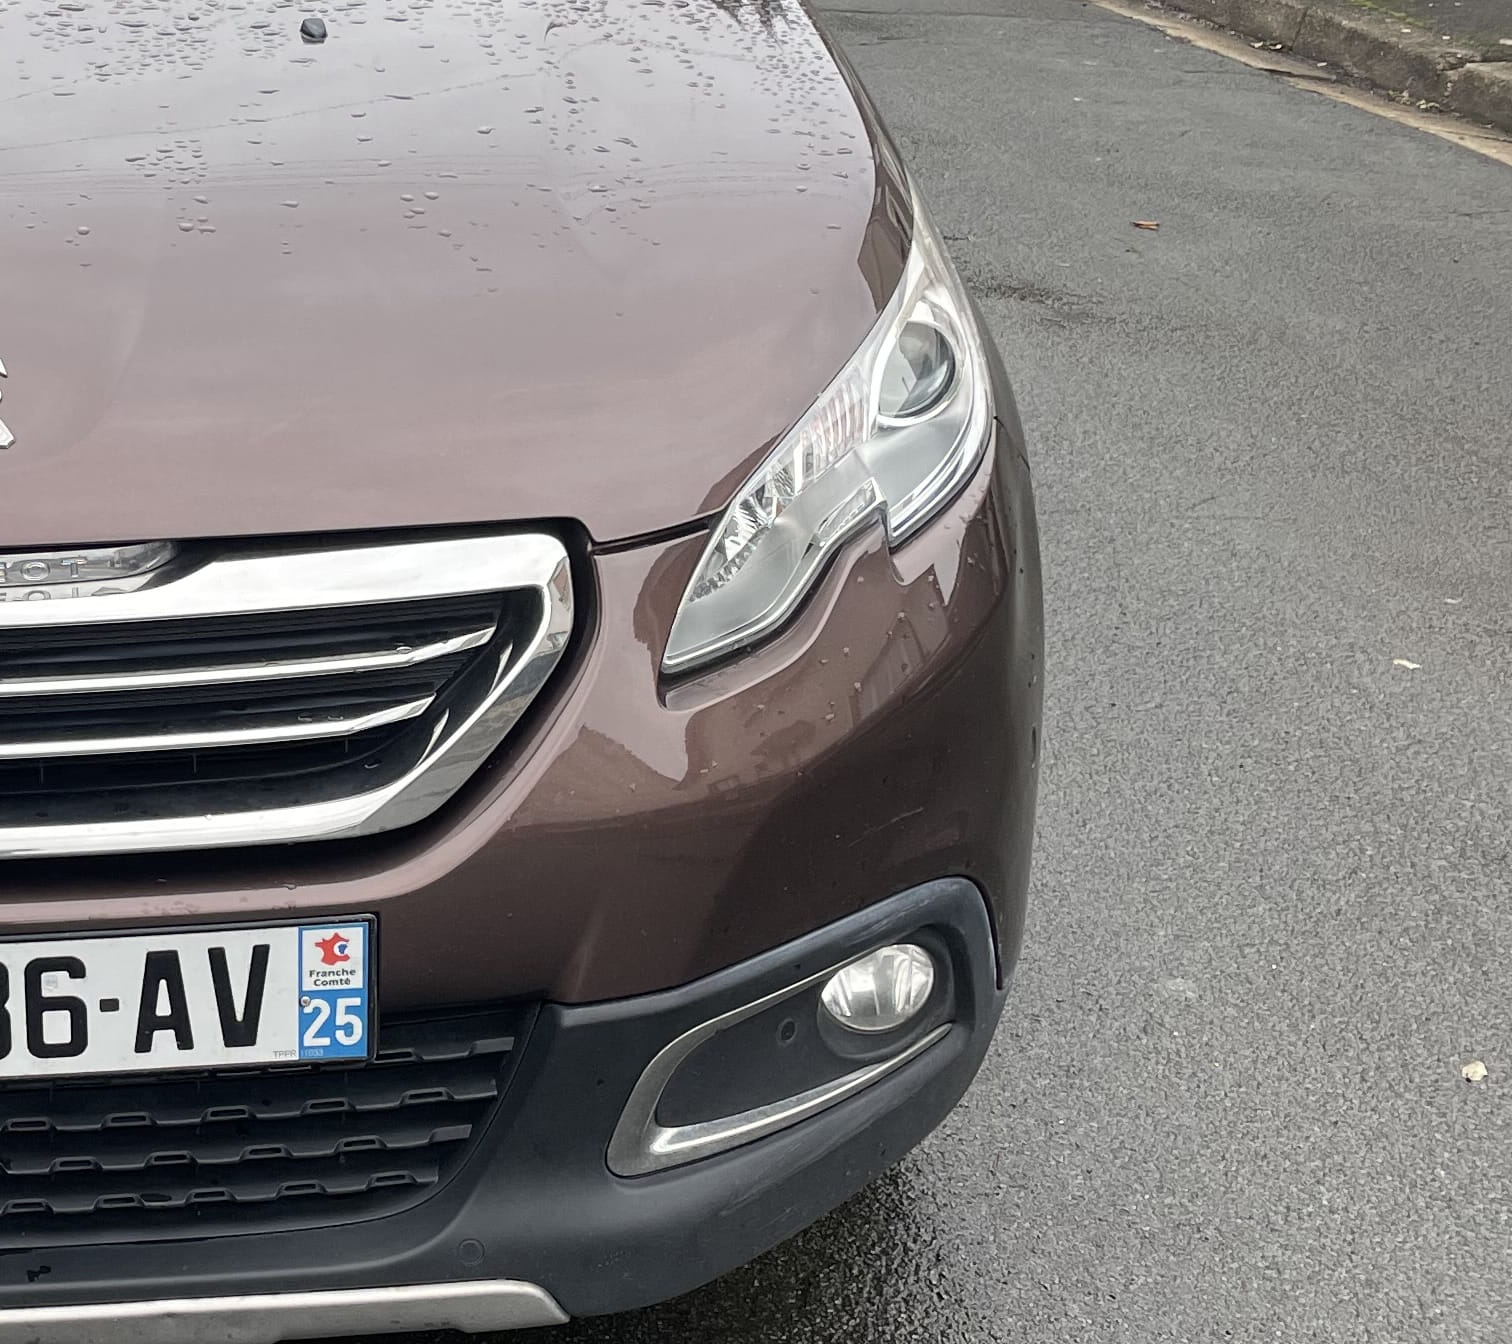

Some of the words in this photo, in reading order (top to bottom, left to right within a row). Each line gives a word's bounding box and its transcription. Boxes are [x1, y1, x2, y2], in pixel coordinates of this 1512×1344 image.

[309, 968, 356, 978] Franche
[313, 977, 351, 987] Comté
[303, 998, 363, 1047] 25
